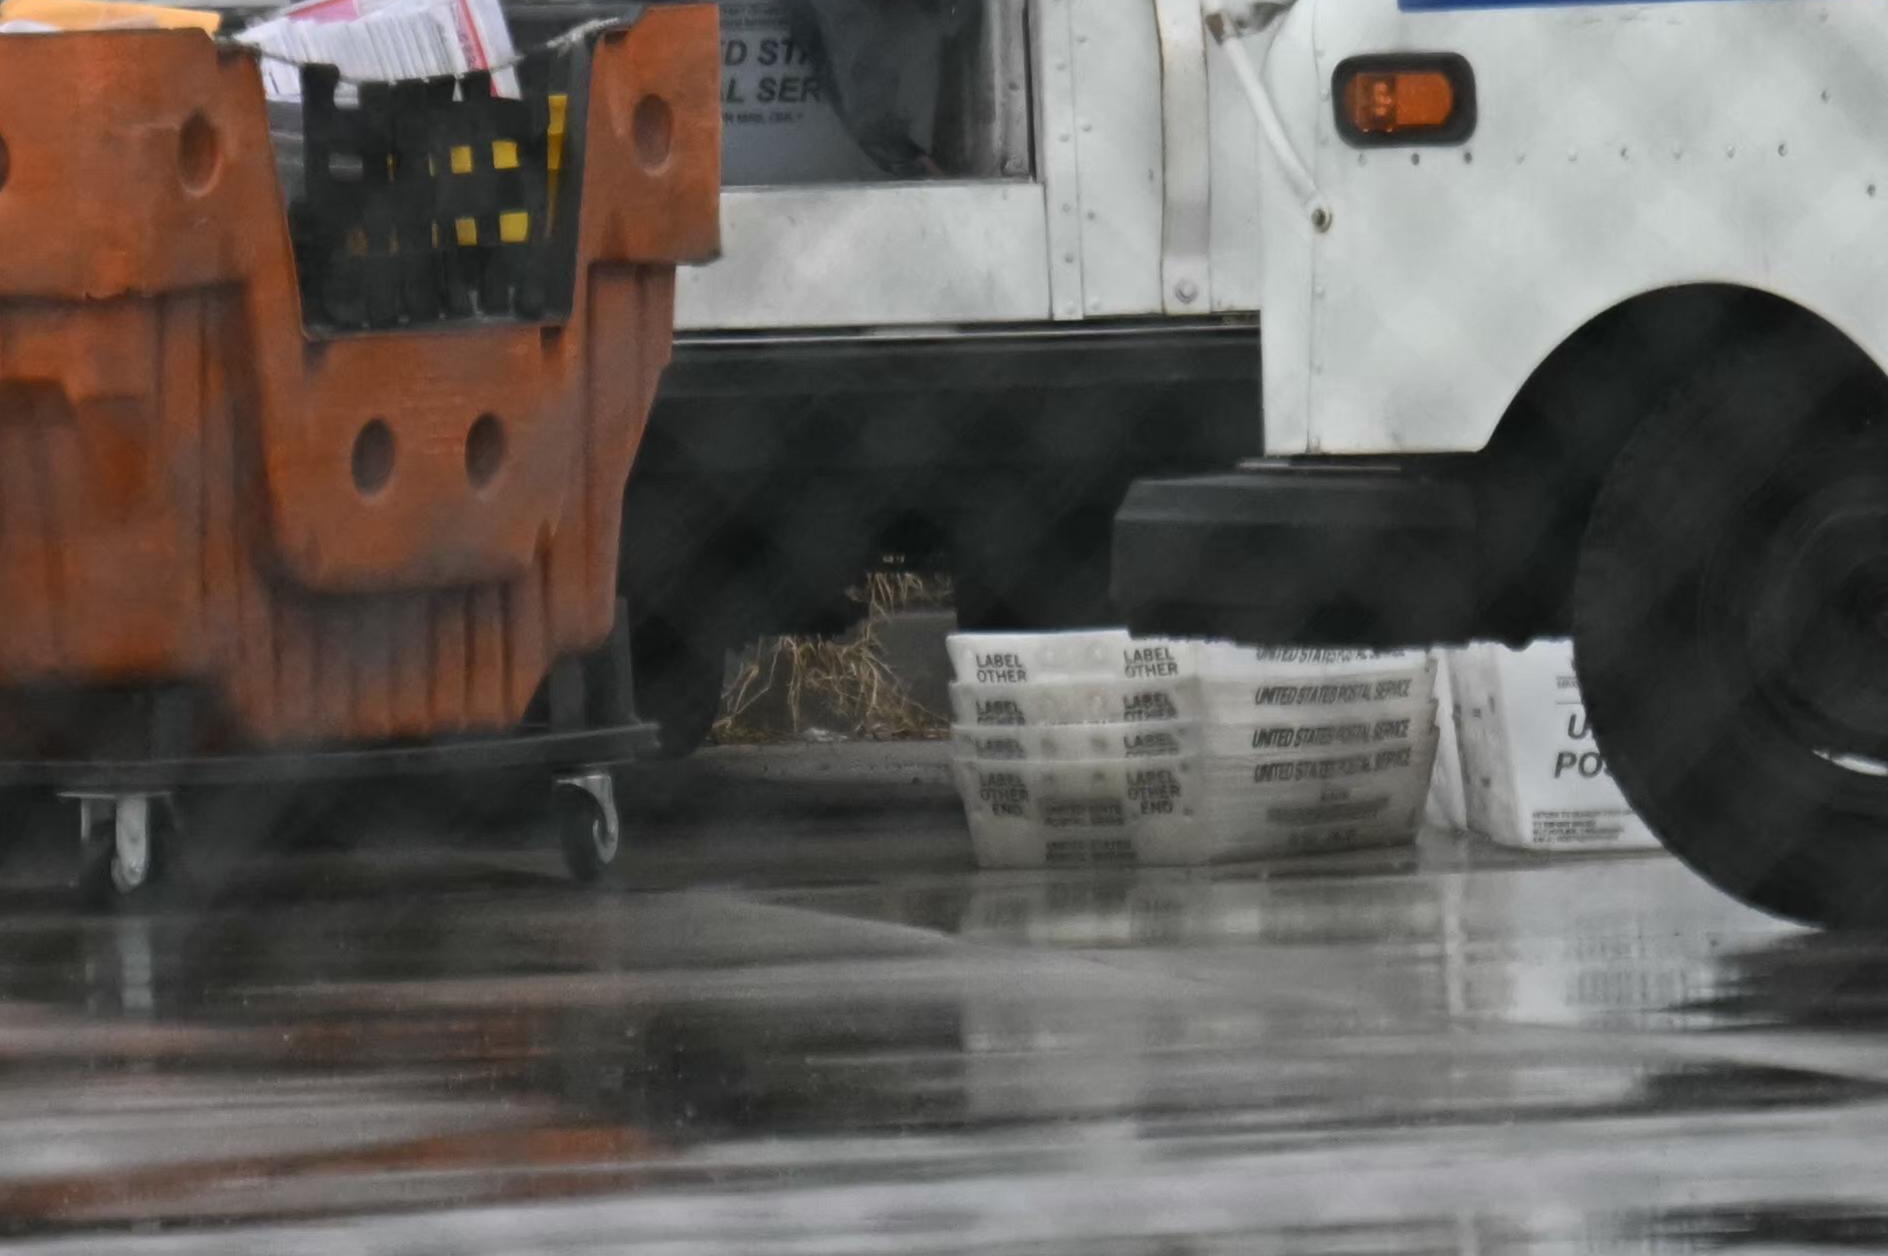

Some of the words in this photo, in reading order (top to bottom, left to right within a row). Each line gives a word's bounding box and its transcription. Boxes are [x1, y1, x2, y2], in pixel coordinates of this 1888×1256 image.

[975, 653, 1023, 669] LABEL
[1123, 647, 1174, 663] LABEL
[976, 668, 1027, 683] OTHER
[1124, 662, 1178, 679] OTHER
[1255, 685, 1297, 705] UNITED
[1252, 727, 1294, 748] UNITED
[1253, 762, 1294, 783] UNITED
[1140, 800, 1174, 815] END
